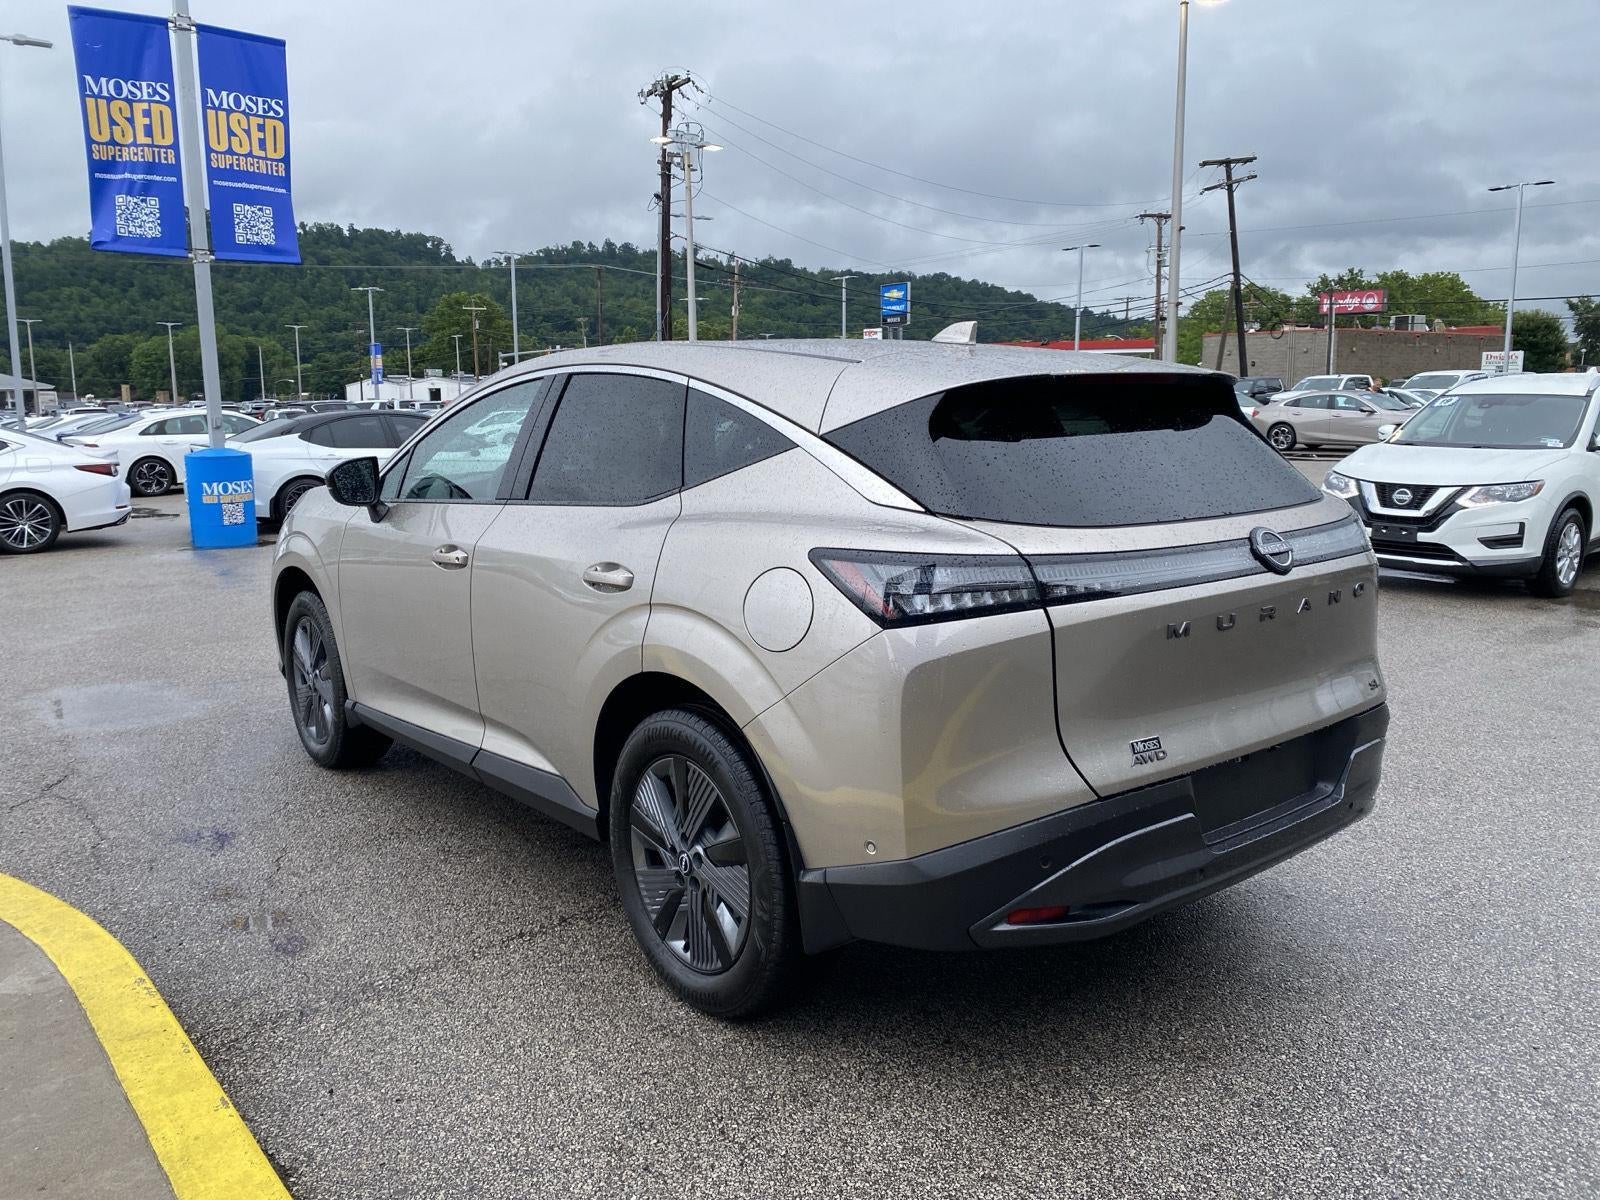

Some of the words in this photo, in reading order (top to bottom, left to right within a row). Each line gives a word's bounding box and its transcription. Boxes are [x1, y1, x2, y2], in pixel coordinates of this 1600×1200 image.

[82, 75, 171, 102] MOSES
[205, 88, 284, 118] MOSES
[85, 97, 174, 146] USED
[206, 109, 285, 160] USED
[91, 144, 176, 165] SUPERCENTER
[210, 153, 286, 177] SUPERCENTER
[94, 172, 177, 183] mosesusedsupercenter.com
[212, 179, 287, 194] mosesusedsupercenter.com
[1166, 581, 1366, 640] MURANO
[1133, 739, 1160, 753] MOSES
[1131, 750, 1168, 767] AWD
